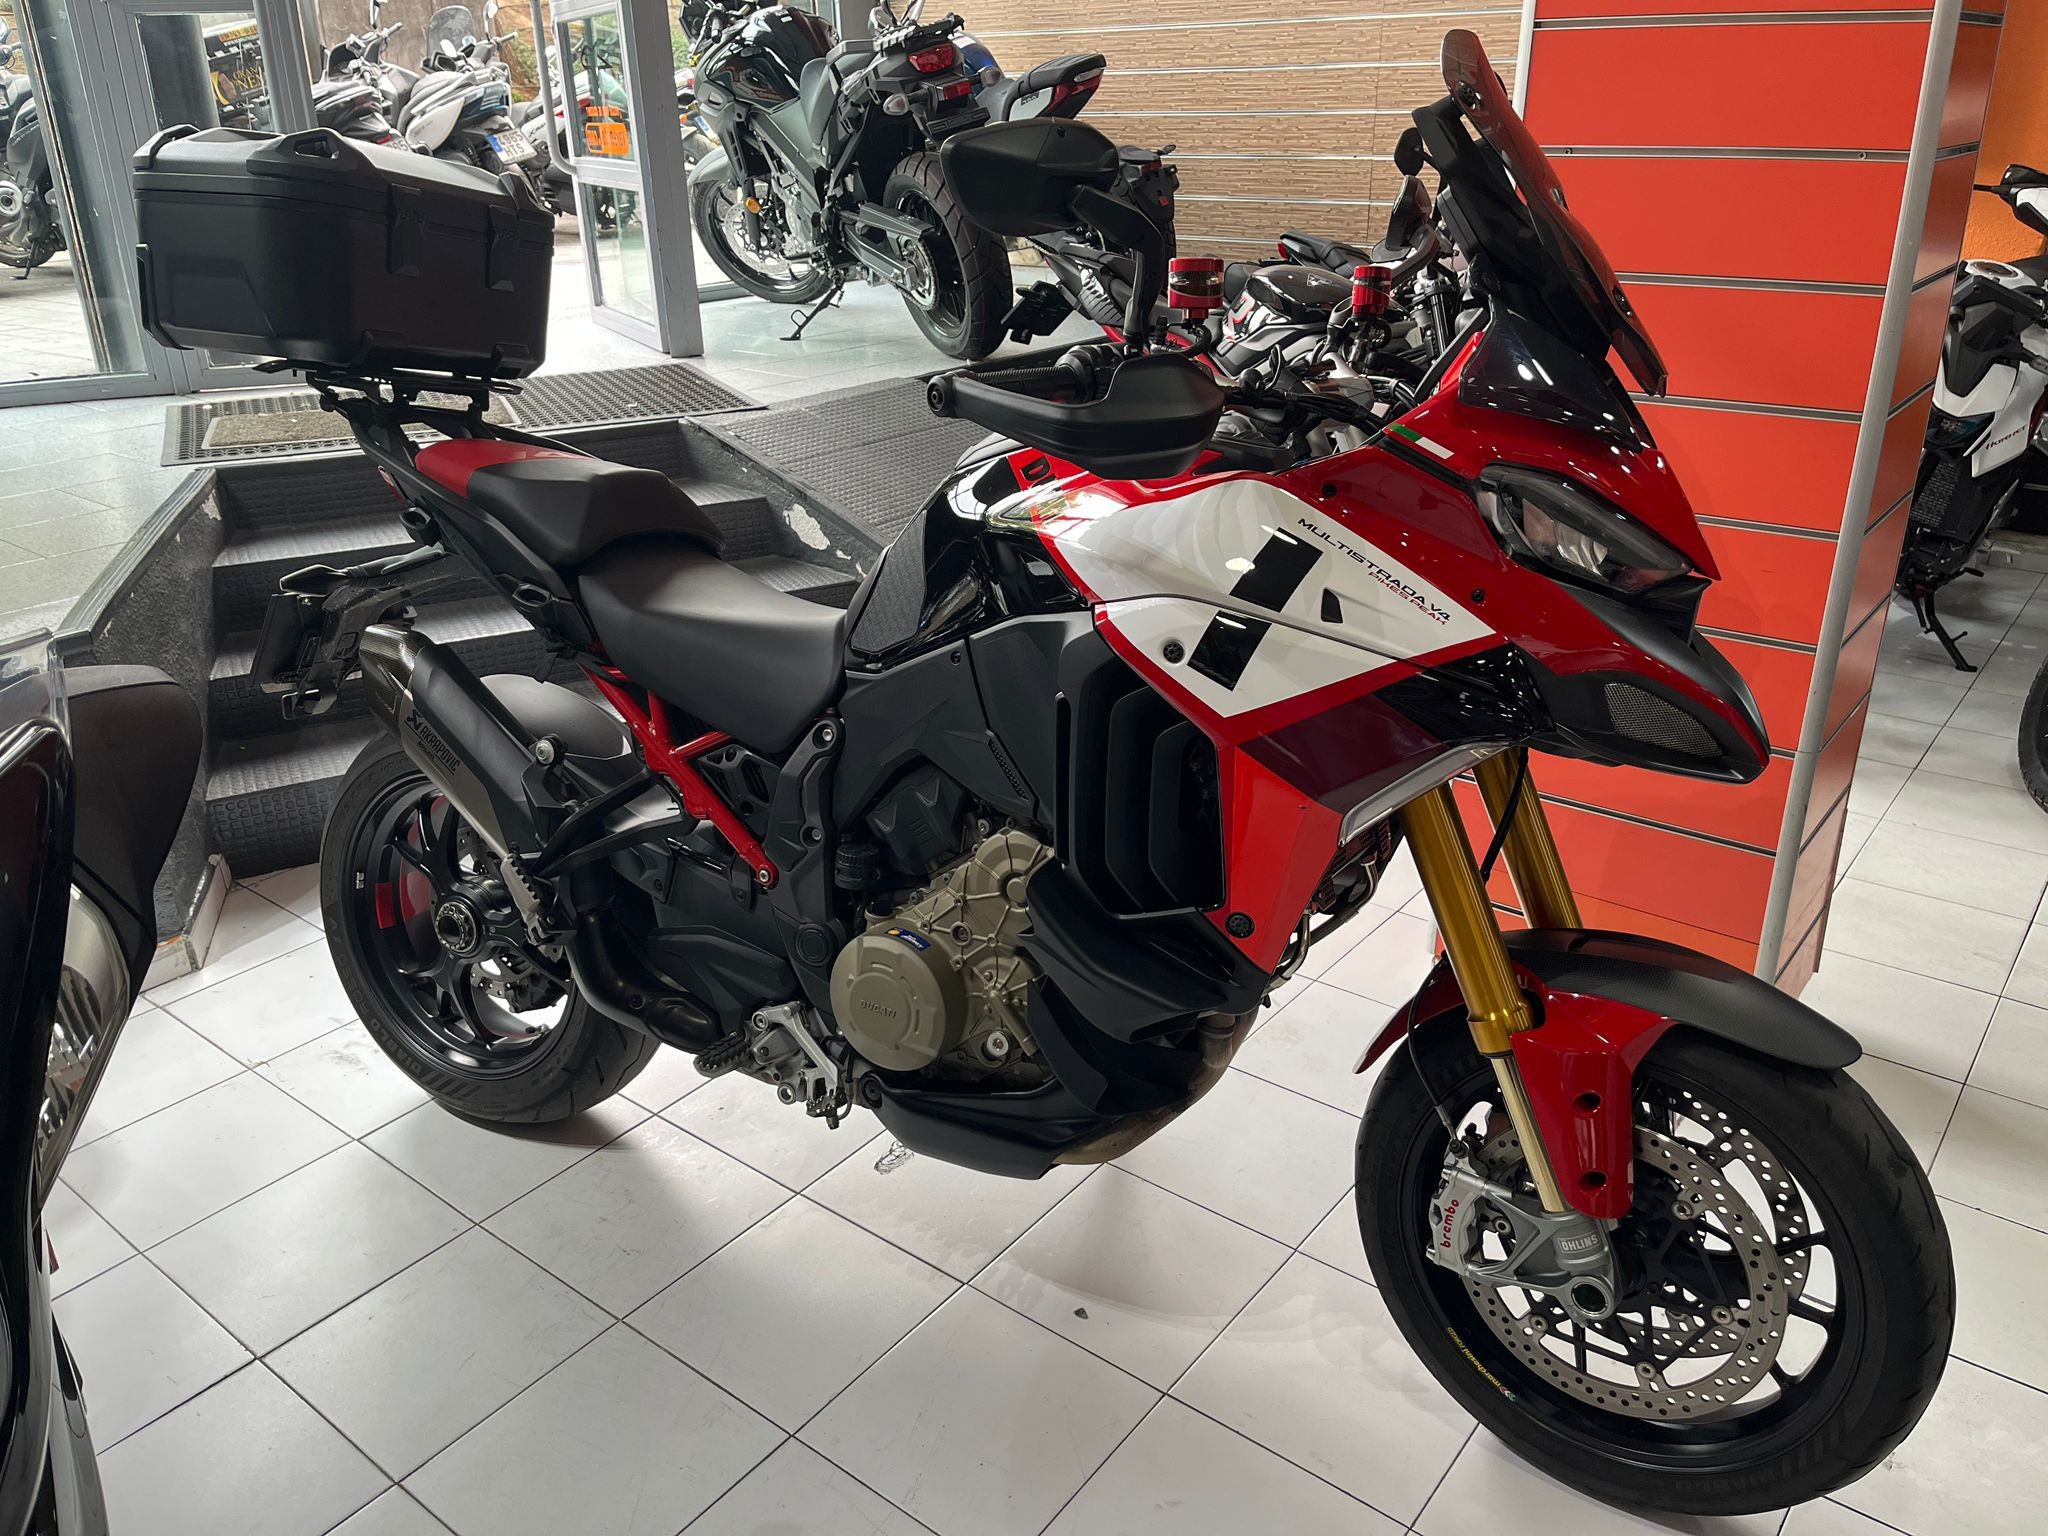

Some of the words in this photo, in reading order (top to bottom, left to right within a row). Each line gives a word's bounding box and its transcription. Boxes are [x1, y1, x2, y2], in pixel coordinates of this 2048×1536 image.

[1298, 518, 1426, 605] MULTISTRADA
[1430, 603, 1451, 621] V4
[1368, 571, 1409, 600] PIKES
[1410, 598, 1447, 625] PEAK
[860, 1000, 897, 1018] DUCATI
[1440, 1199, 1459, 1248] brembo
